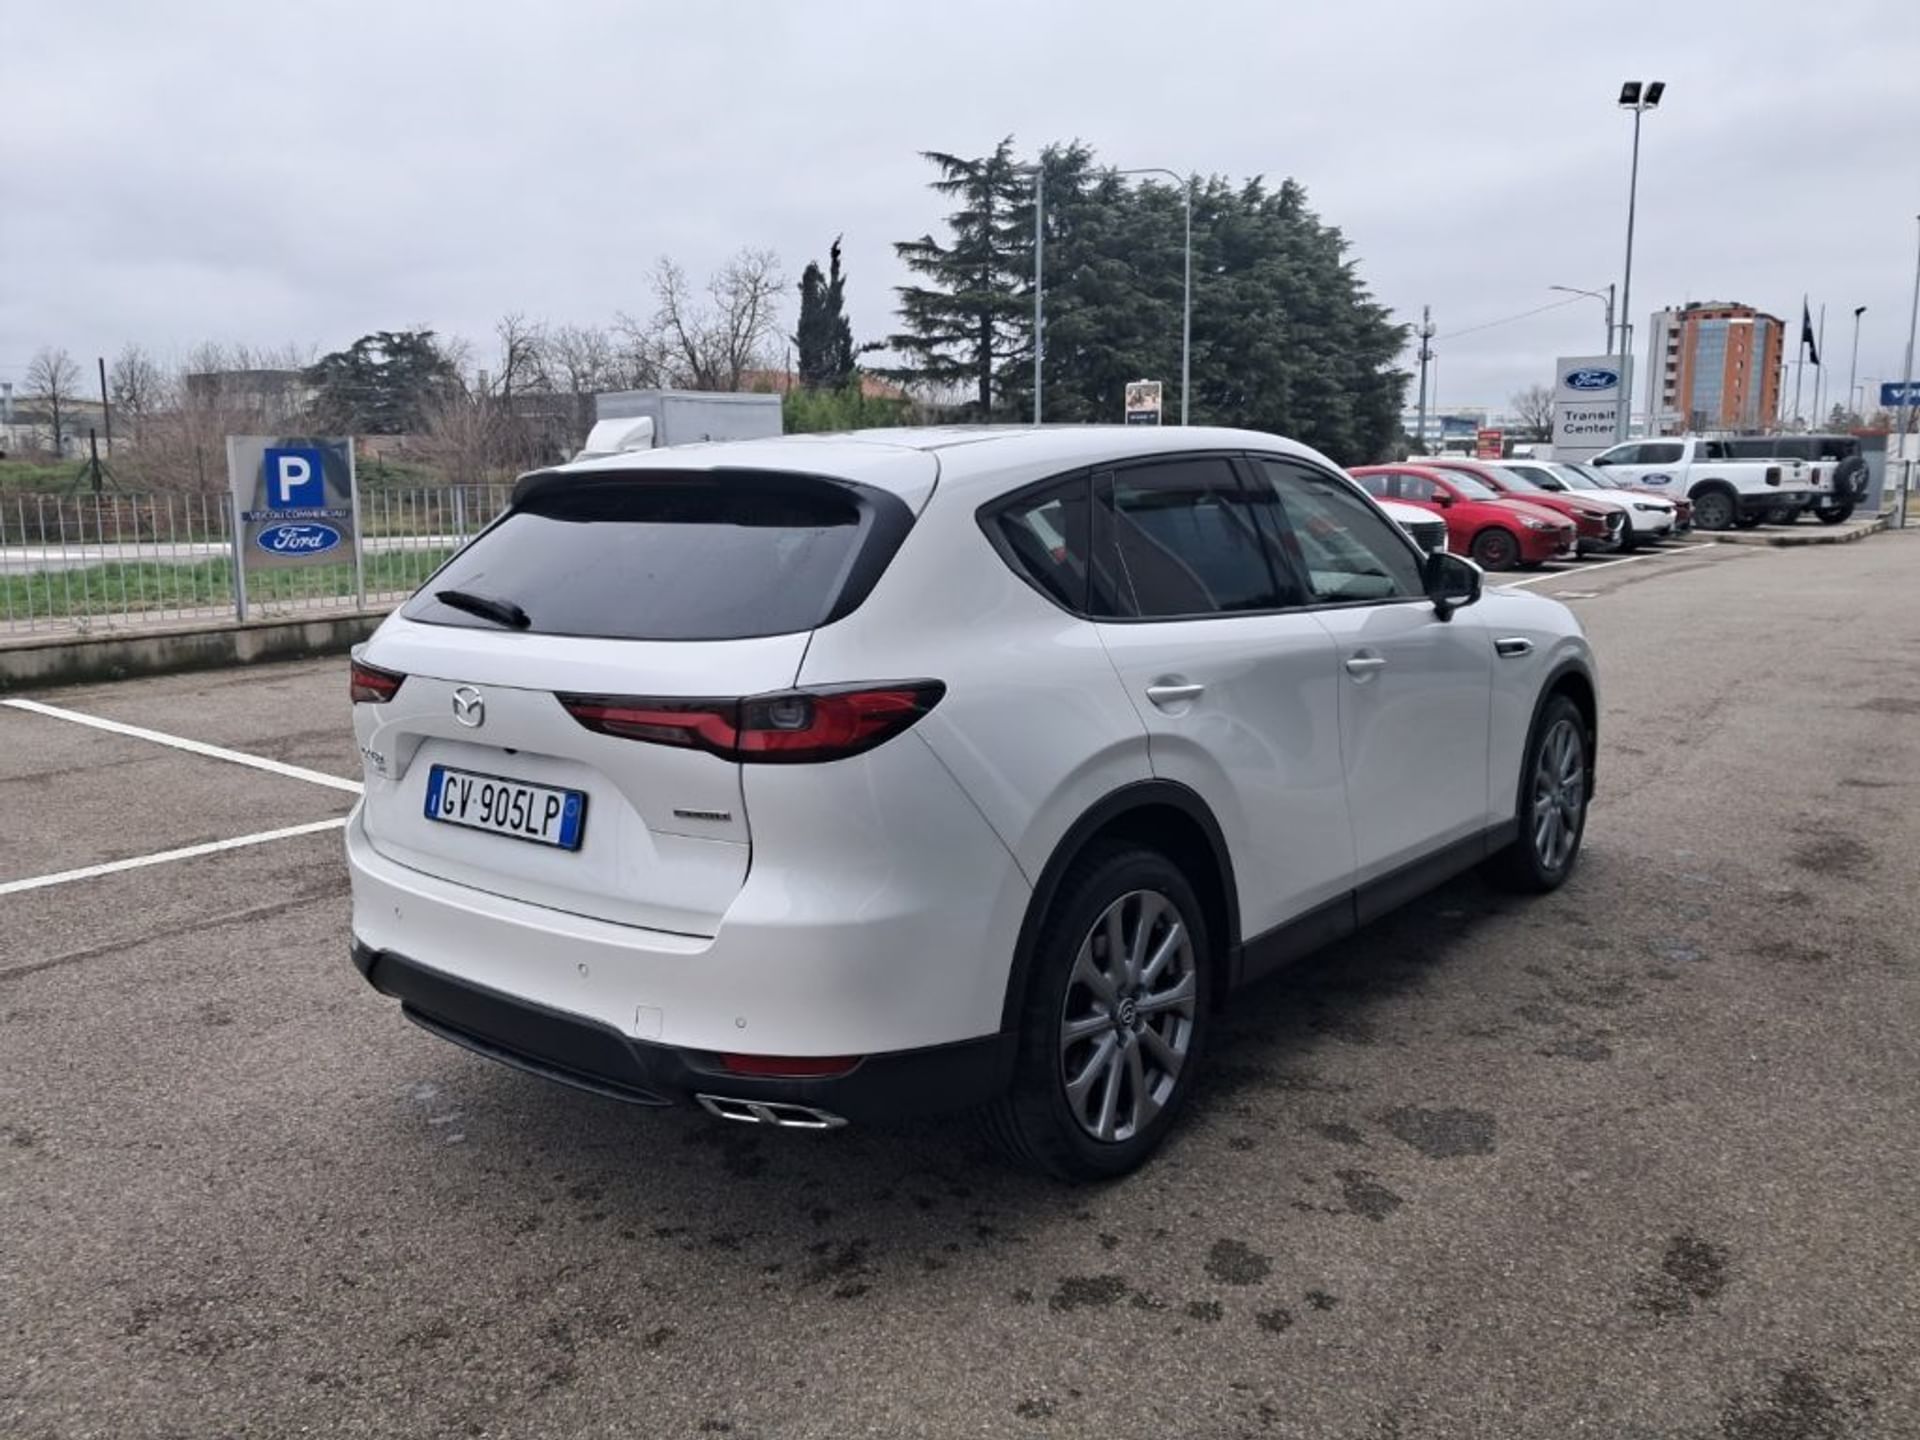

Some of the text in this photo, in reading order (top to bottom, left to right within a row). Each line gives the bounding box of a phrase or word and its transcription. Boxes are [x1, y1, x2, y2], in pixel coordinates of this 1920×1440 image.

[1565, 411, 1615, 421] Transit
[1563, 423, 1615, 434] Center
[278, 456, 311, 502] P
[273, 527, 324, 549] Ford
[443, 777, 560, 836] GV 905LP
